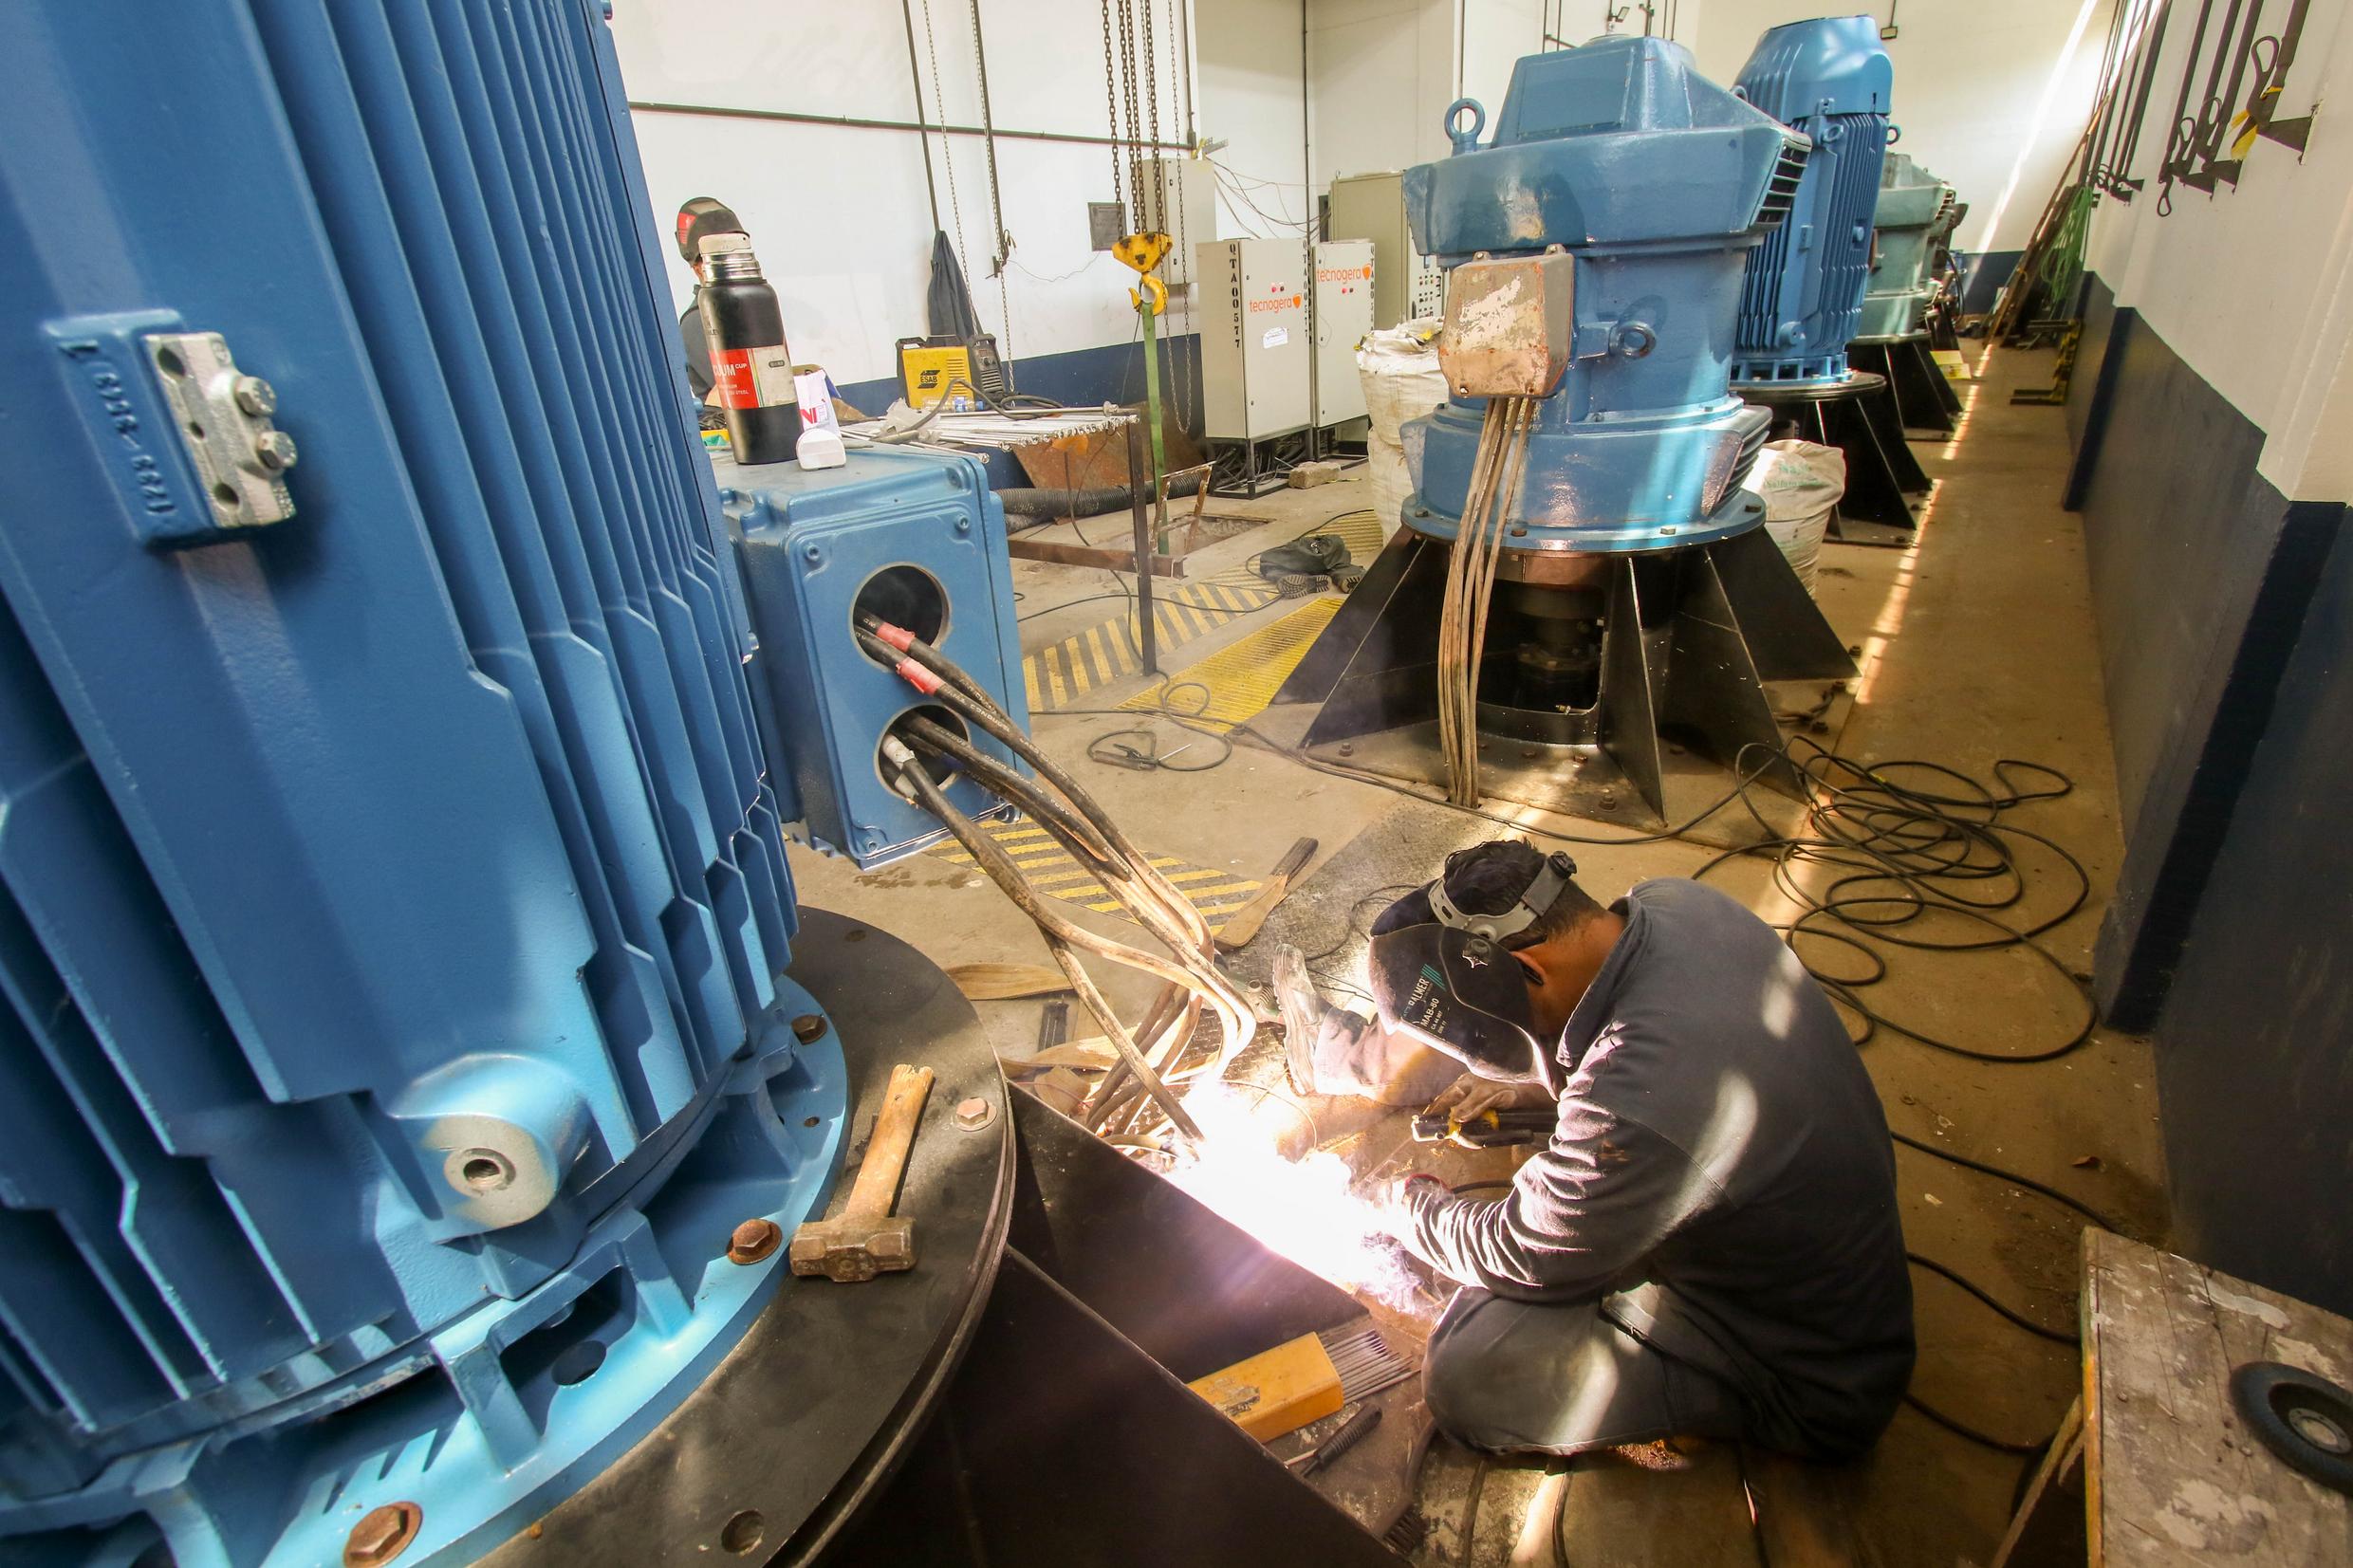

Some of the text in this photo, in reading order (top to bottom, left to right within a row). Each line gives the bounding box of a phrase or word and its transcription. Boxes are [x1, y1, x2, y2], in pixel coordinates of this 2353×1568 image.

[1317, 268, 1361, 284] tecnogera
[1229, 244, 1240, 348] QTA00577
[1250, 297, 1292, 313] tecnogera
[1420, 997, 1440, 1027] MAB-80
